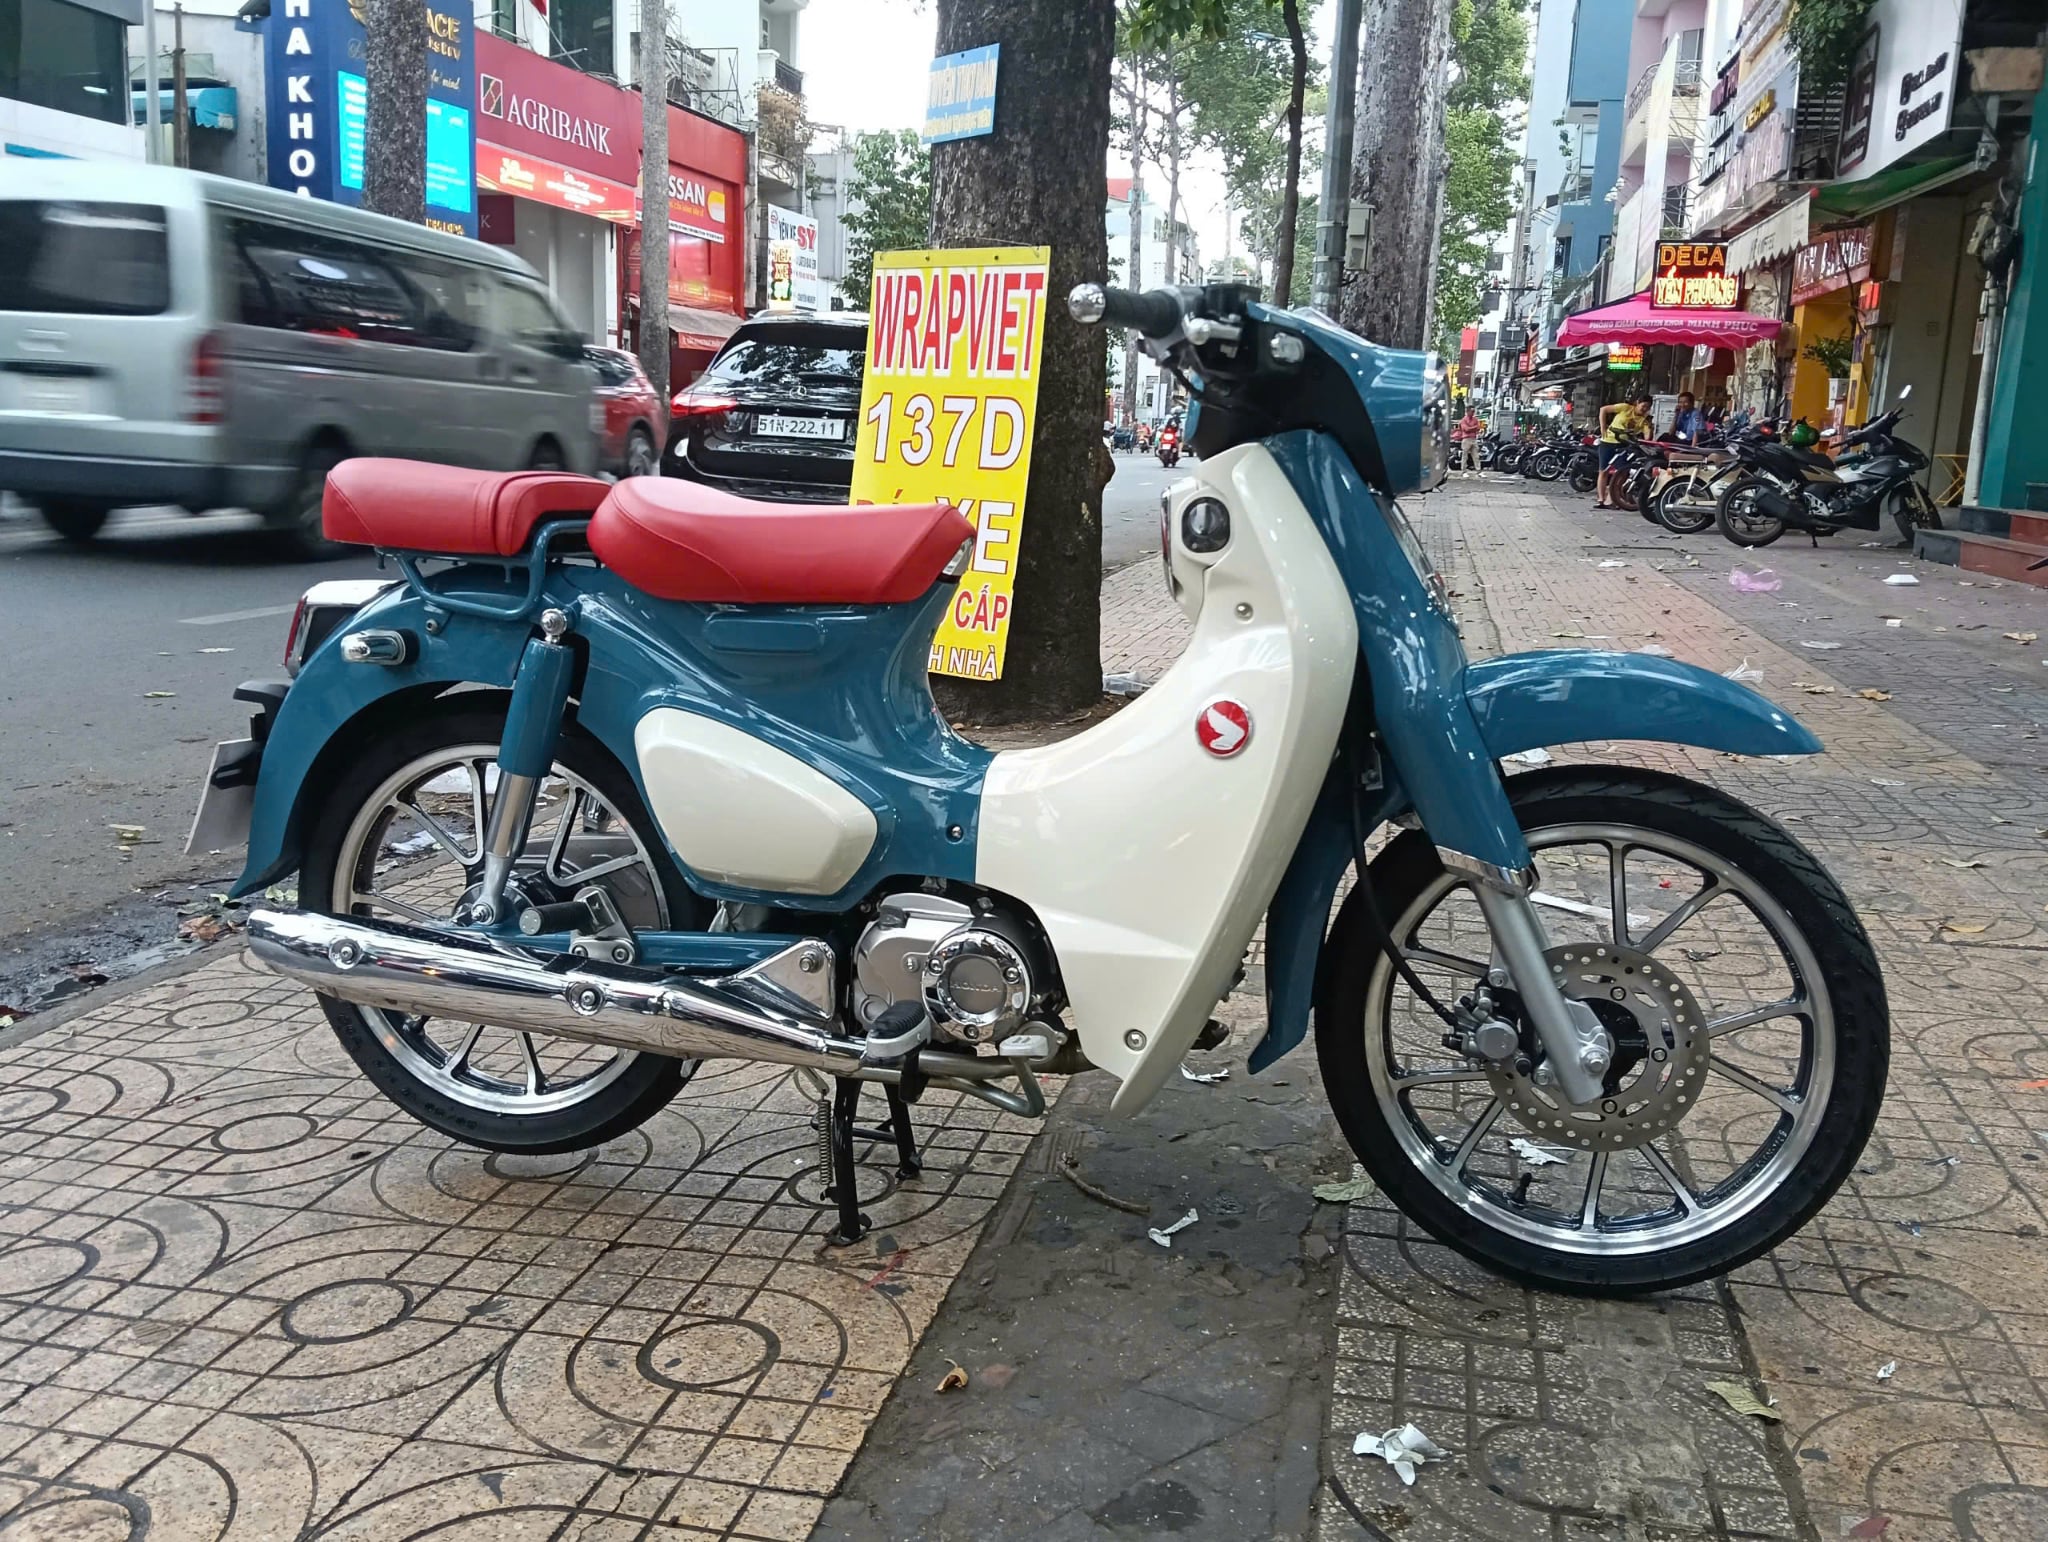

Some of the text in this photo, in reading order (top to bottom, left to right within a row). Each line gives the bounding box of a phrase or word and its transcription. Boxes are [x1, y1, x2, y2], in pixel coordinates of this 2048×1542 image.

[507, 94, 612, 156] AGRIBANK
[872, 272, 1045, 372] WRAPVIET
[759, 418, 835, 437] 51N-222.11
[867, 392, 1026, 471] 137D
[955, 584, 1008, 632] CẤP
[949, 645, 998, 680] NHÀ
